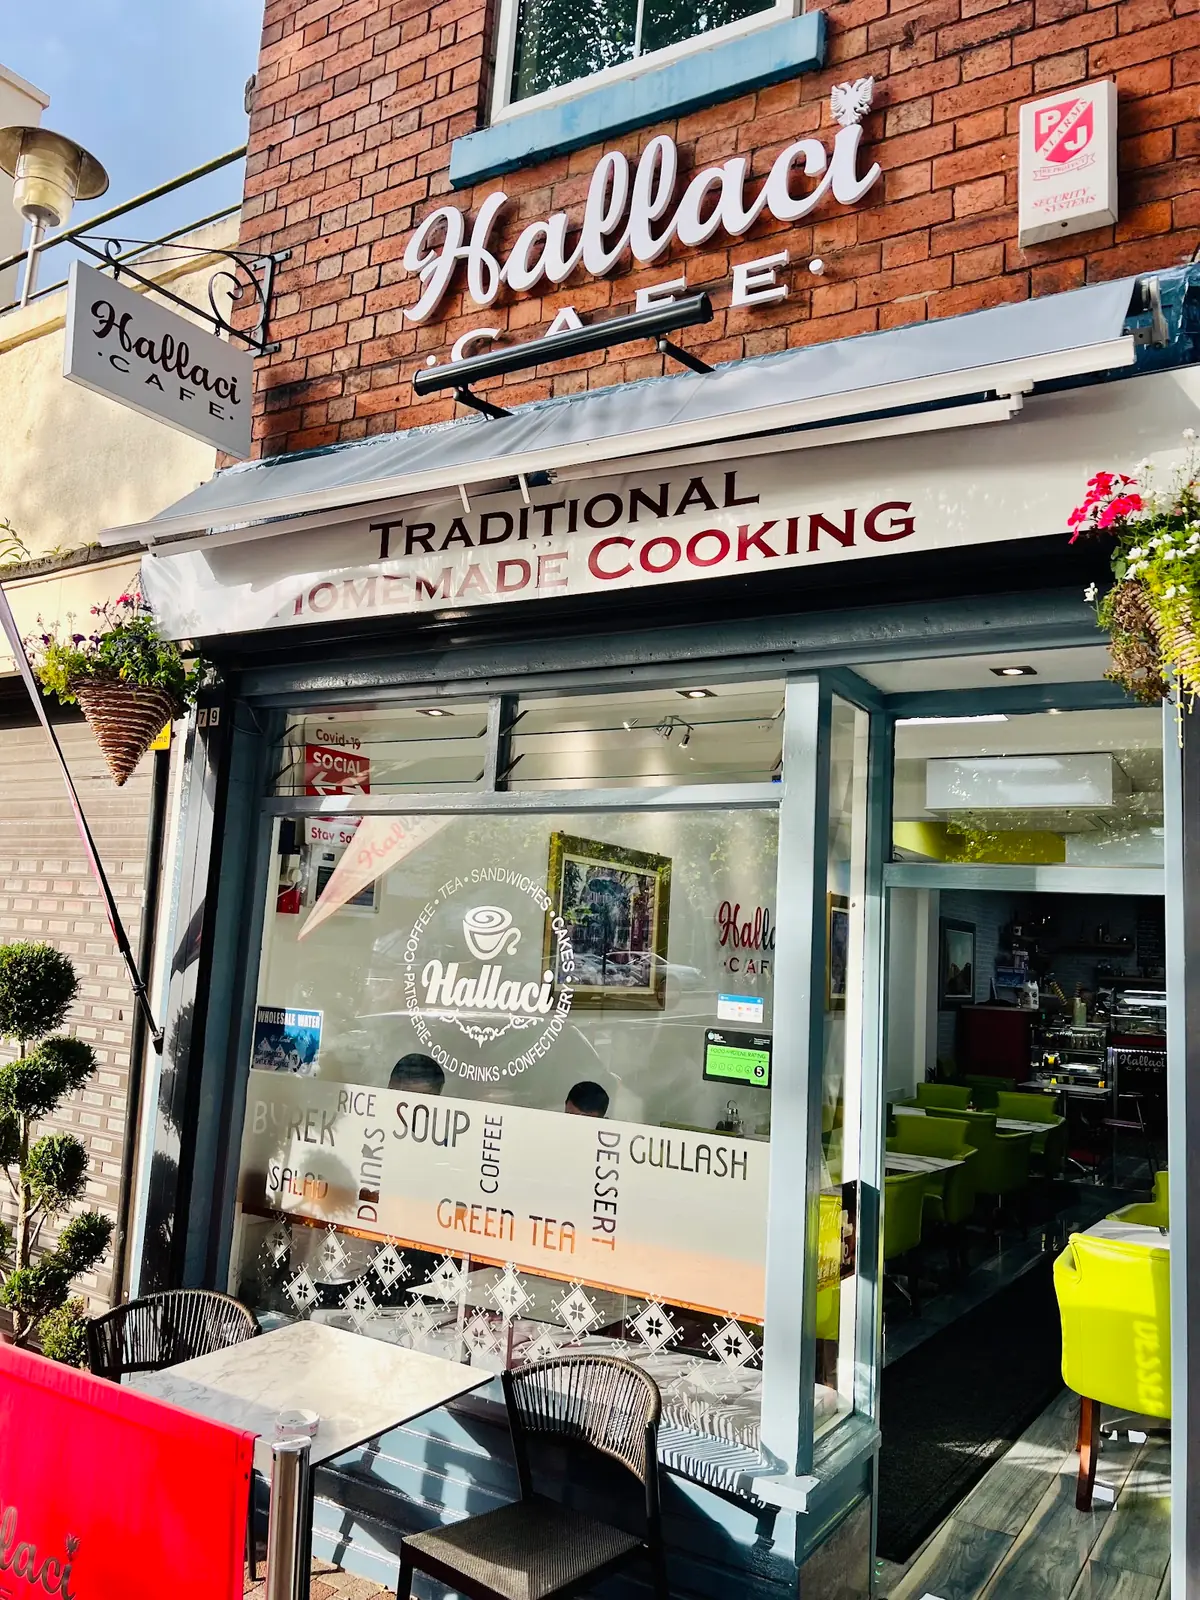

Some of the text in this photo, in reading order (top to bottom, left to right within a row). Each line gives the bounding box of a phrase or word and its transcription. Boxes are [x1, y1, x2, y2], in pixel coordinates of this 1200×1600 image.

[1042, 97, 1088, 156] ALARMS
[403, 124, 882, 323] Hallaci
[1031, 187, 1090, 209] SECURITY
[1044, 194, 1097, 214] SYSTEMS
[91, 300, 241, 405] Hallaci
[369, 471, 760, 559] TRADITIONAL
[587, 501, 916, 581] COOKING
[438, 877, 465, 900] TEA
[471, 867, 552, 911] SANDWICHES
[403, 903, 437, 962] COFFEE
[551, 916, 576, 973] CAKES
[403, 972, 432, 1045] PATISSERIE
[421, 959, 555, 1014] Hallaci
[258, 1010, 320, 1029] WHOLESALE WATER
[507, 983, 576, 1077] CONFECTIONERY
[430, 1044, 500, 1082] COLD DRINKS
[1119, 1053, 1166, 1068] Hallaci
[337, 1090, 377, 1118] RICE
[392, 1101, 471, 1148] SOUP
[479, 1114, 503, 1194] COFFEE
[629, 1135, 748, 1181] GULLASH
[269, 1165, 329, 1200] SALAD
[591, 1130, 621, 1251] DESSERT
[529, 1214, 576, 1254] TEA
